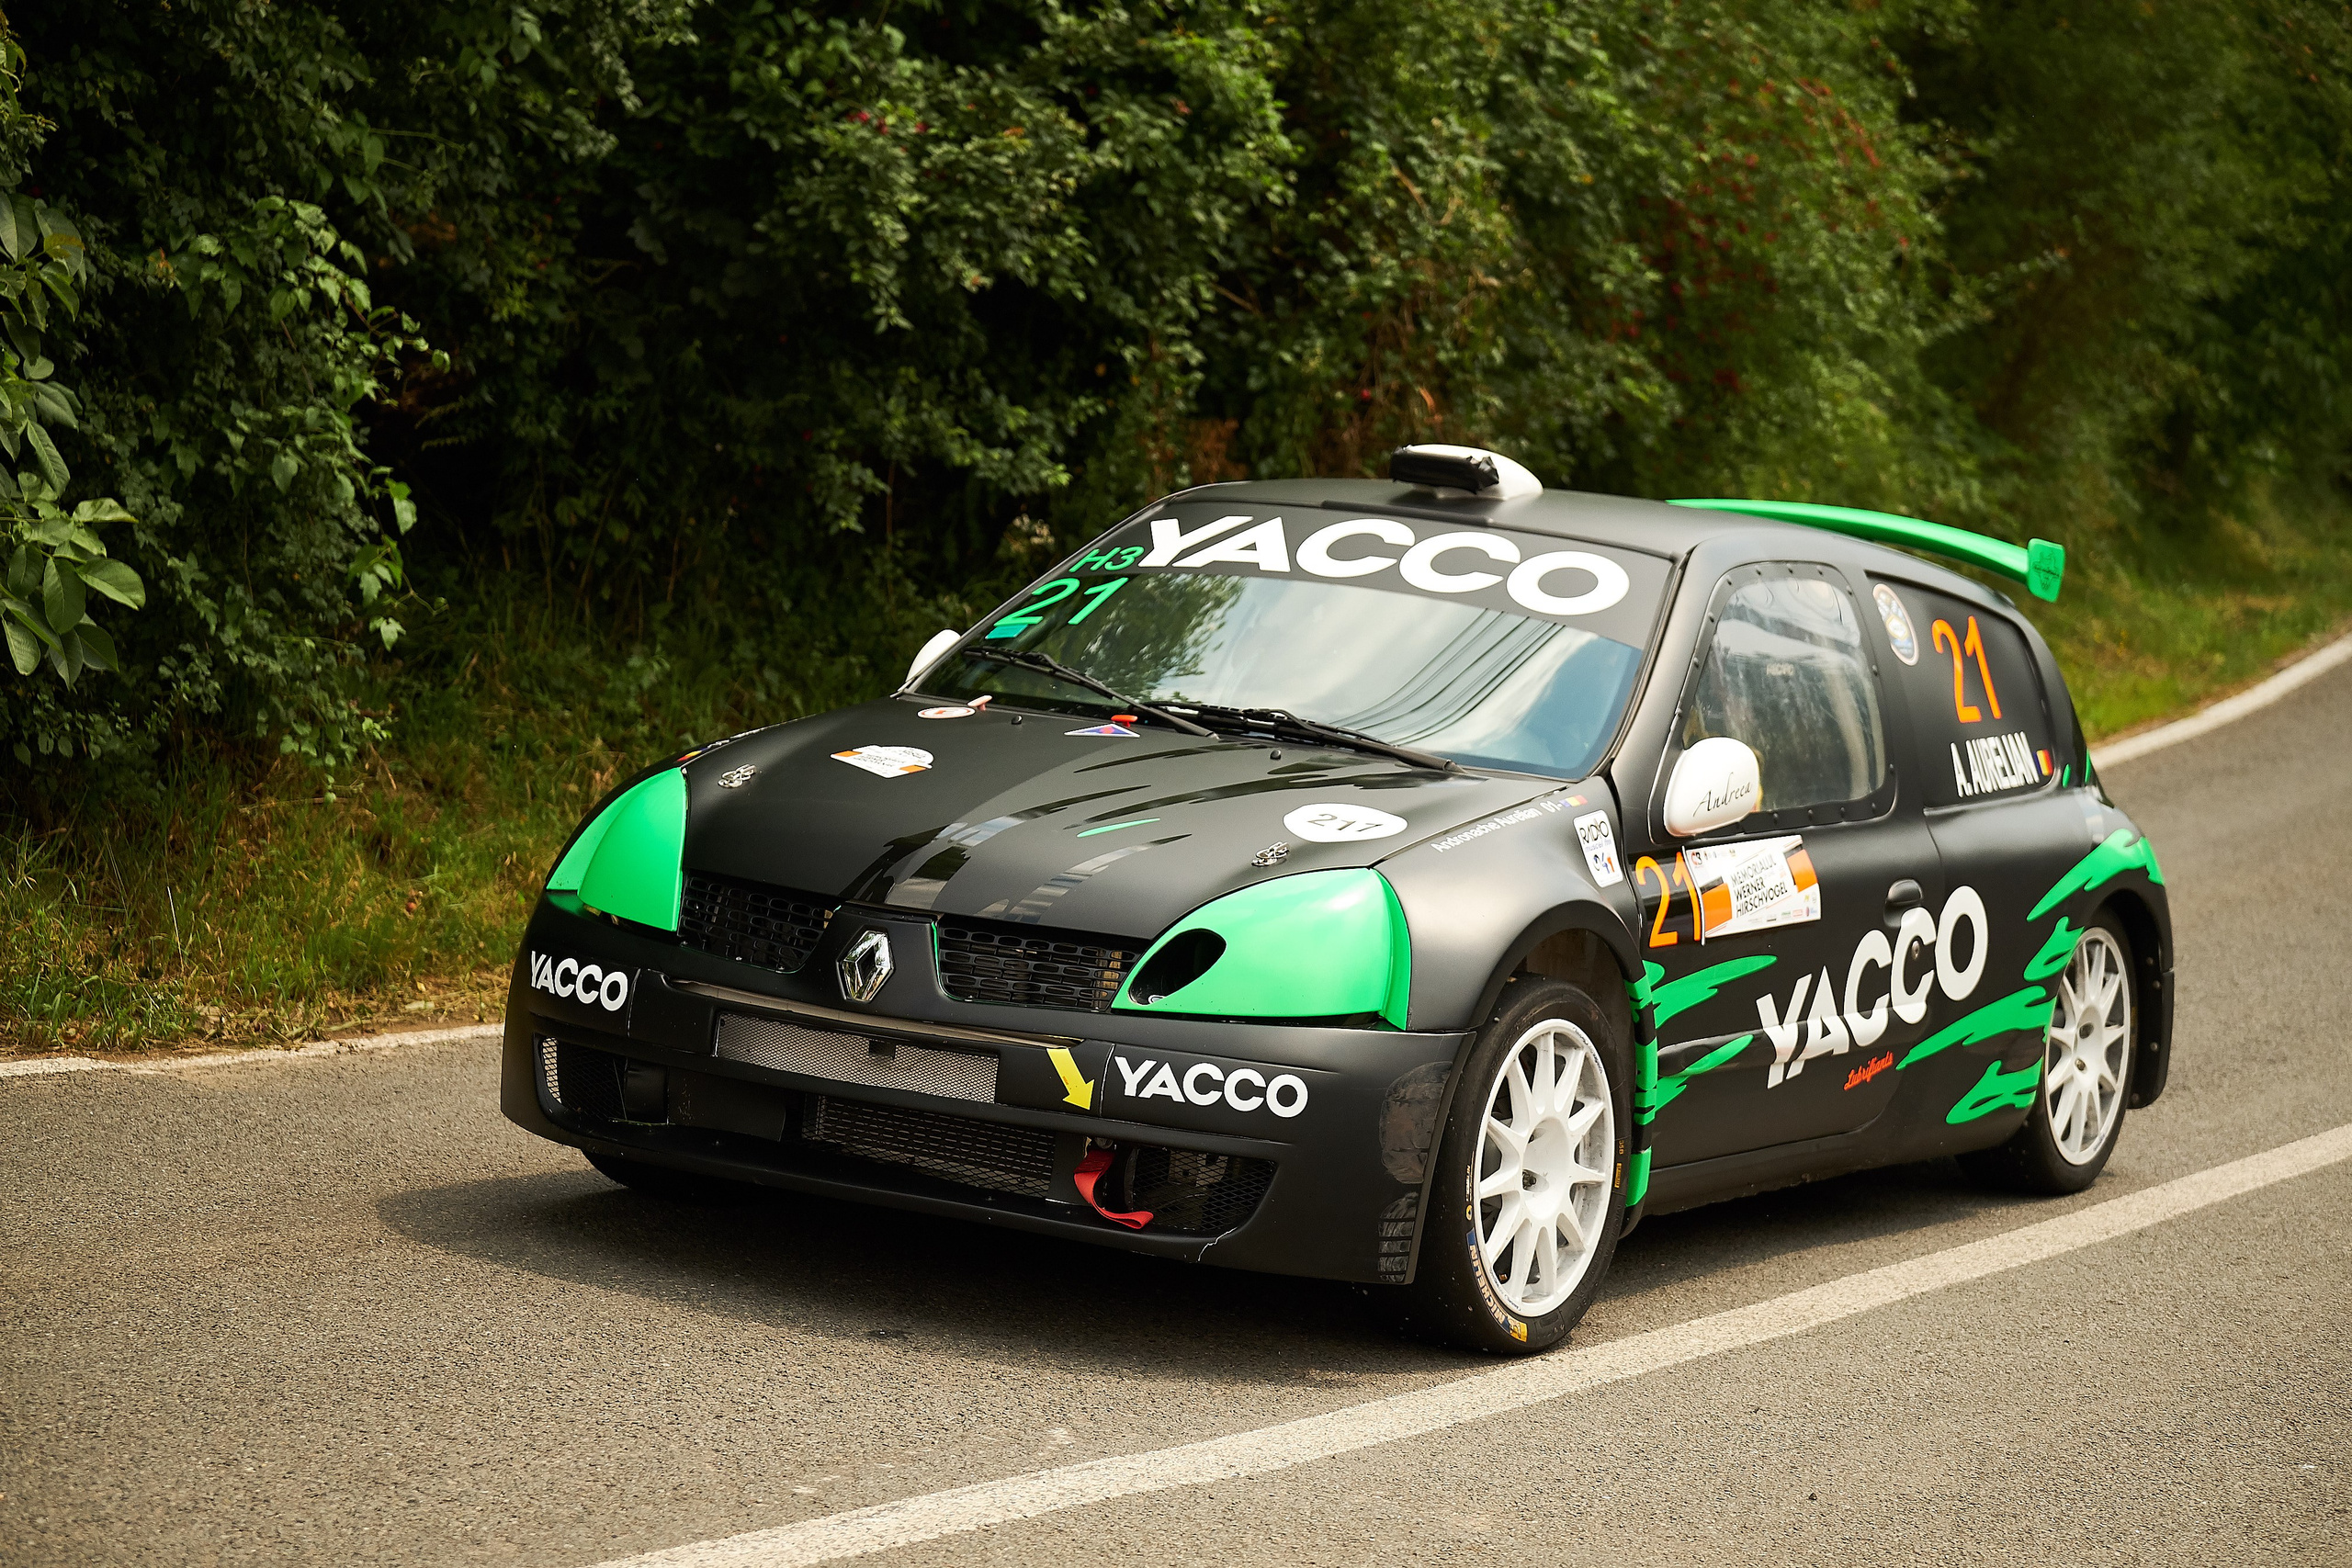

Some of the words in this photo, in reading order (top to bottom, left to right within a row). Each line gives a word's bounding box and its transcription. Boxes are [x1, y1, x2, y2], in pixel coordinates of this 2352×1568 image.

[1069, 546, 1145, 572] H3
[1137, 514, 1630, 615] YACCO
[993, 577, 1129, 626] 21
[1931, 615, 2002, 723] 21
[1692, 772, 1751, 817] Andreea
[1430, 819, 1501, 852] Andronache
[1494, 807, 1543, 829] Aurelian
[1731, 853, 1777, 887] MEMORIALUL
[1734, 876, 1766, 902] WERNER
[1635, 852, 1701, 948] 21
[1736, 881, 1788, 919] HIRSCHVOGEL
[530, 950, 629, 1011] YACCO
[1756, 885, 1989, 1089] YACCO
[1114, 1055, 1308, 1118] YACCO
[1844, 1051, 1894, 1090] Lubrifiants
[1470, 1245, 1506, 1325] MICHELIN
